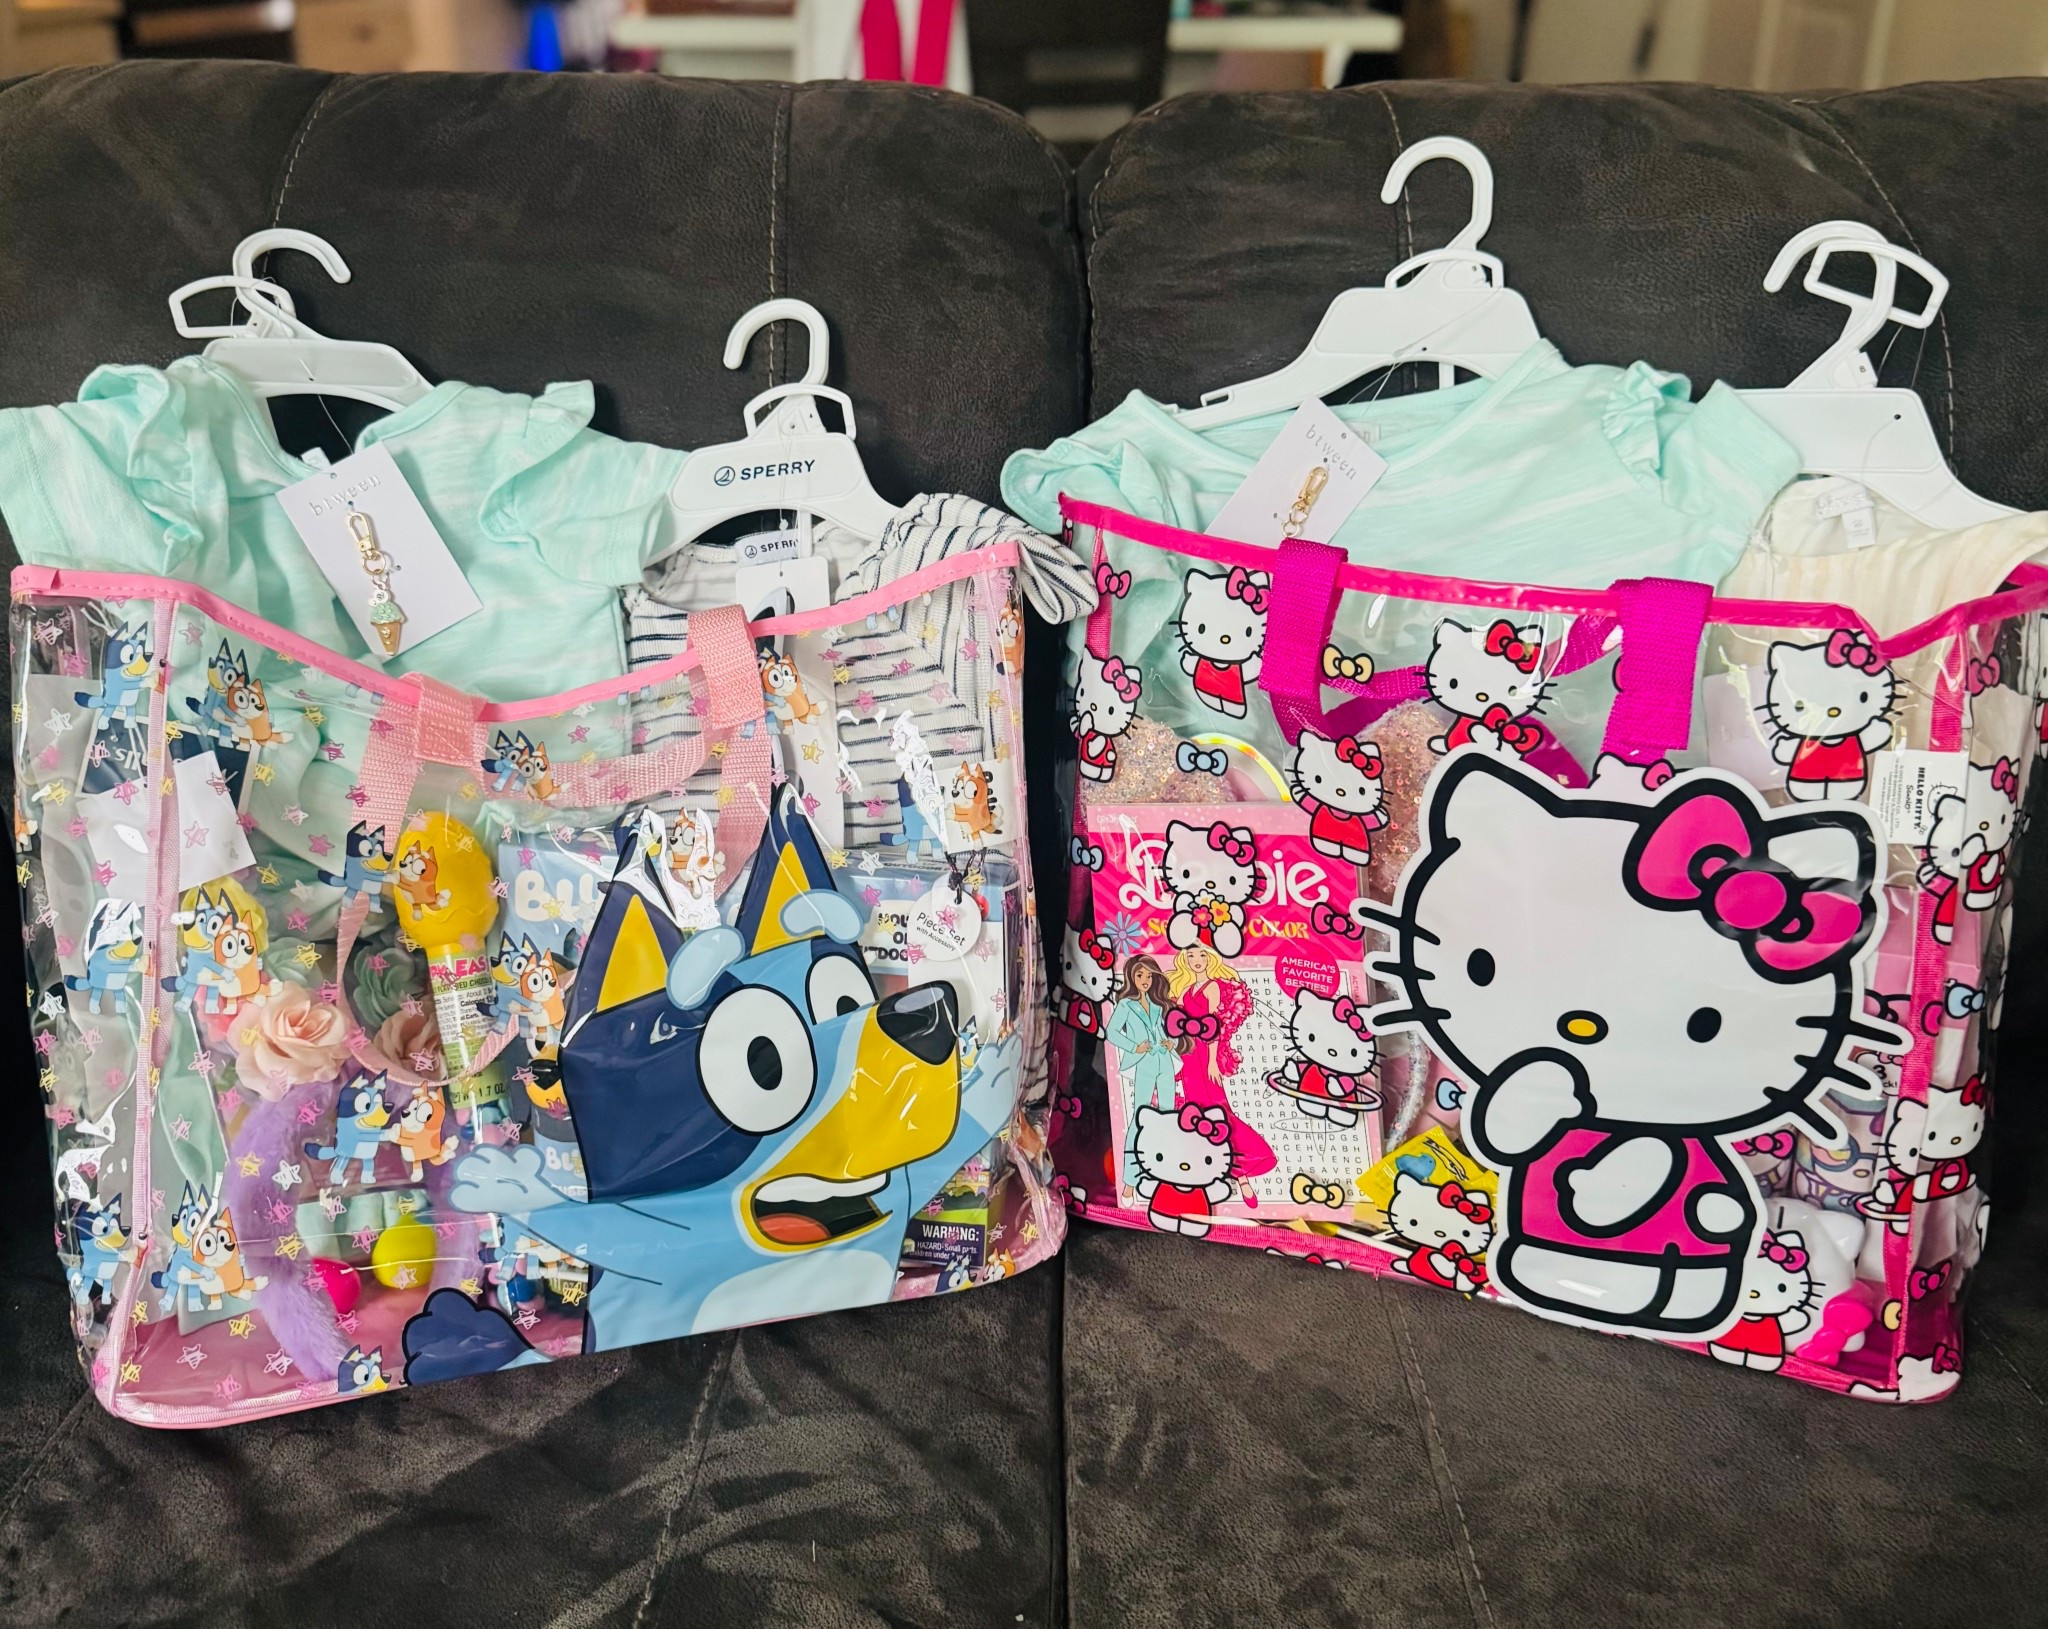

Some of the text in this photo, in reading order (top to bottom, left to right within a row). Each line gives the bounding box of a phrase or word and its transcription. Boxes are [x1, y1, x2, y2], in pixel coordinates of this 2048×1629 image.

[1305, 424, 1357, 480] btween
[740, 459, 815, 480] SPERRY
[1917, 767, 1925, 796] HELLO
[1281, 956, 1336, 974] AMERICA'S
[1282, 966, 1334, 984] FAVORITE
[1285, 977, 1330, 993] BESTIES!
